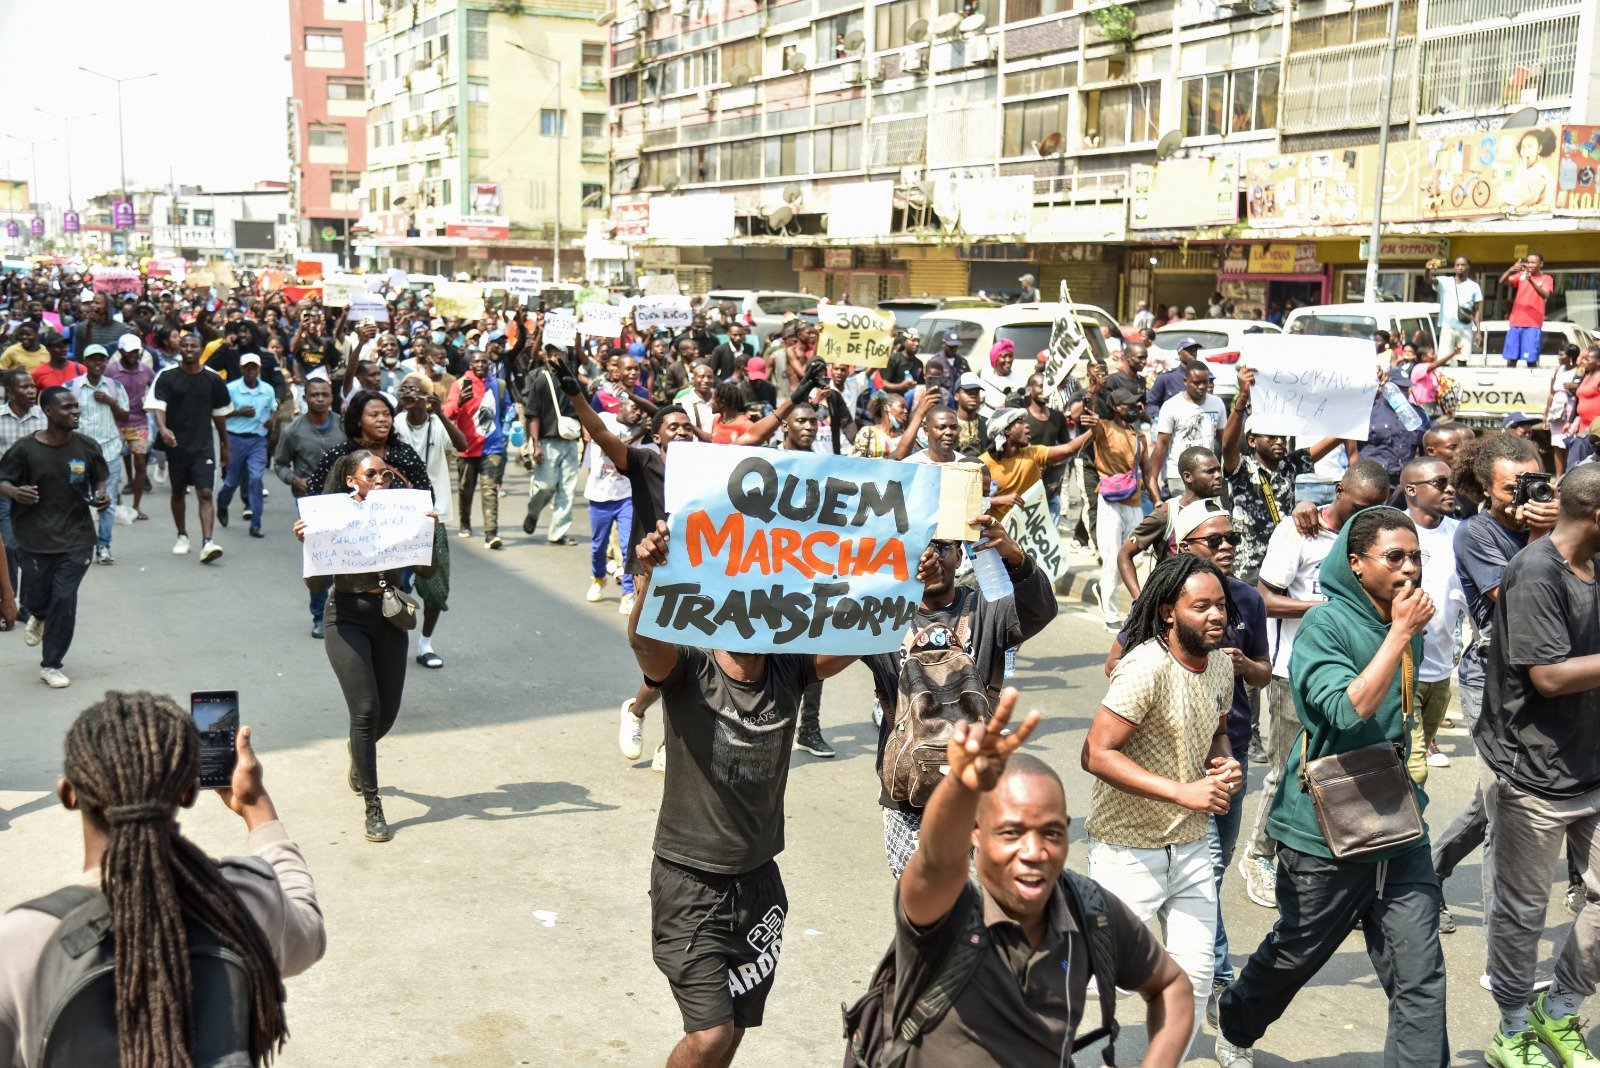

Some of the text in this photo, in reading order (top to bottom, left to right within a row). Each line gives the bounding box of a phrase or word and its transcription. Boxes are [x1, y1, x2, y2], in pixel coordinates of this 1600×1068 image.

[837, 312, 870, 330] 300
[847, 342, 862, 354] DE
[1460, 390, 1526, 405] OYOTA
[727, 456, 909, 535] QUEM
[1022, 501, 1061, 577] ANGOLA
